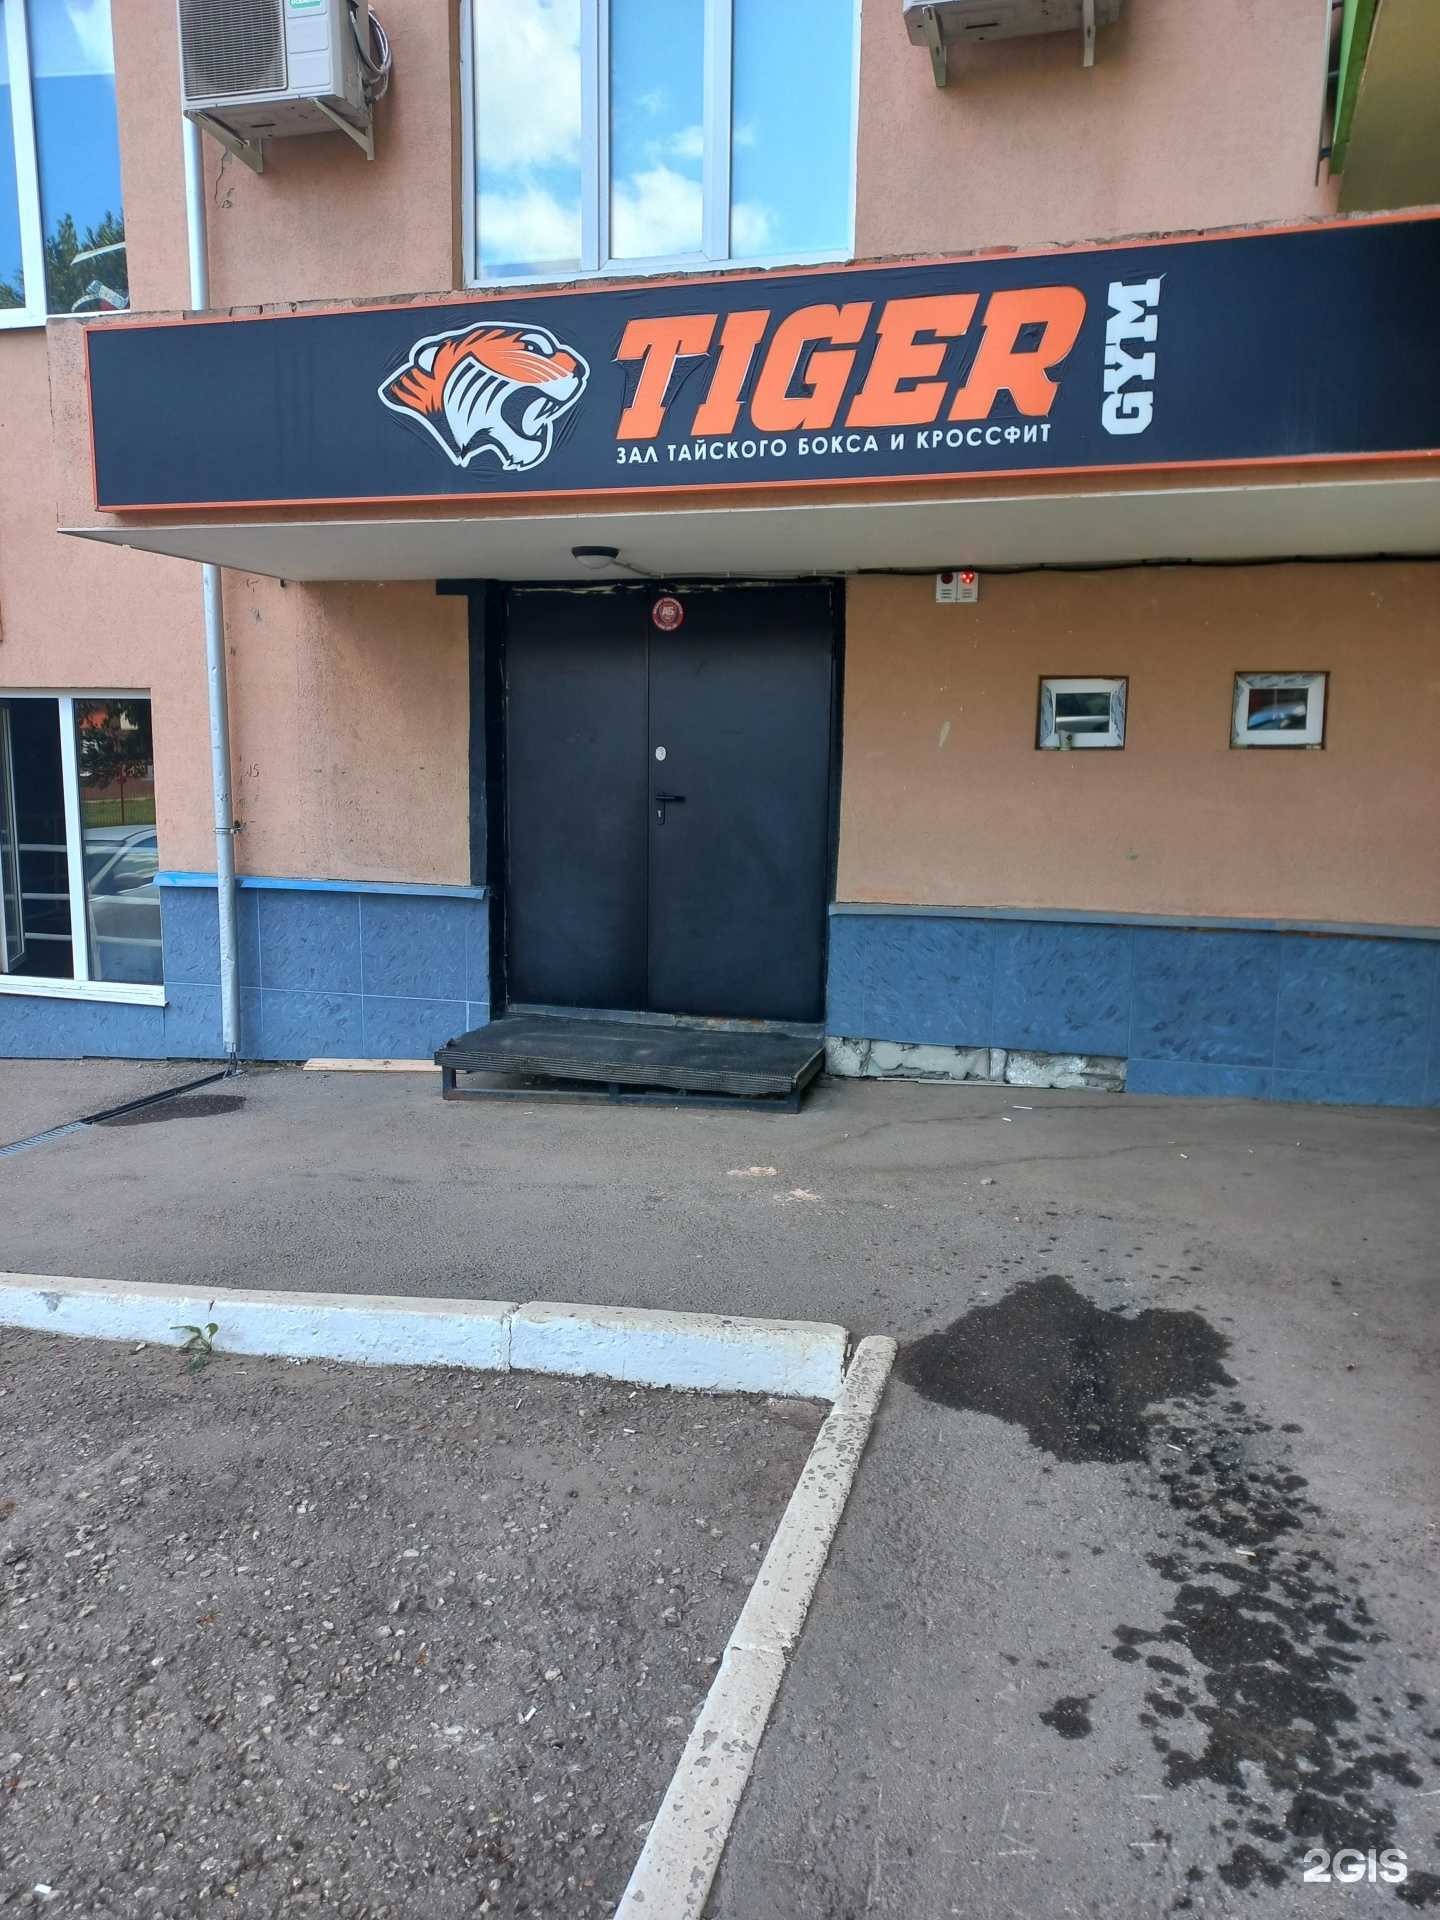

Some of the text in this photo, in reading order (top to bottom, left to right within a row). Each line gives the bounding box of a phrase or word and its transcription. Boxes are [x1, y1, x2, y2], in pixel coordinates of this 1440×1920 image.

[614, 285, 1087, 440] TIGER
[1101, 277, 1161, 435] GYM
[616, 423, 1052, 465] ЗАЛ ТАЙСКОГО БОКСА И КРОССФИТ
